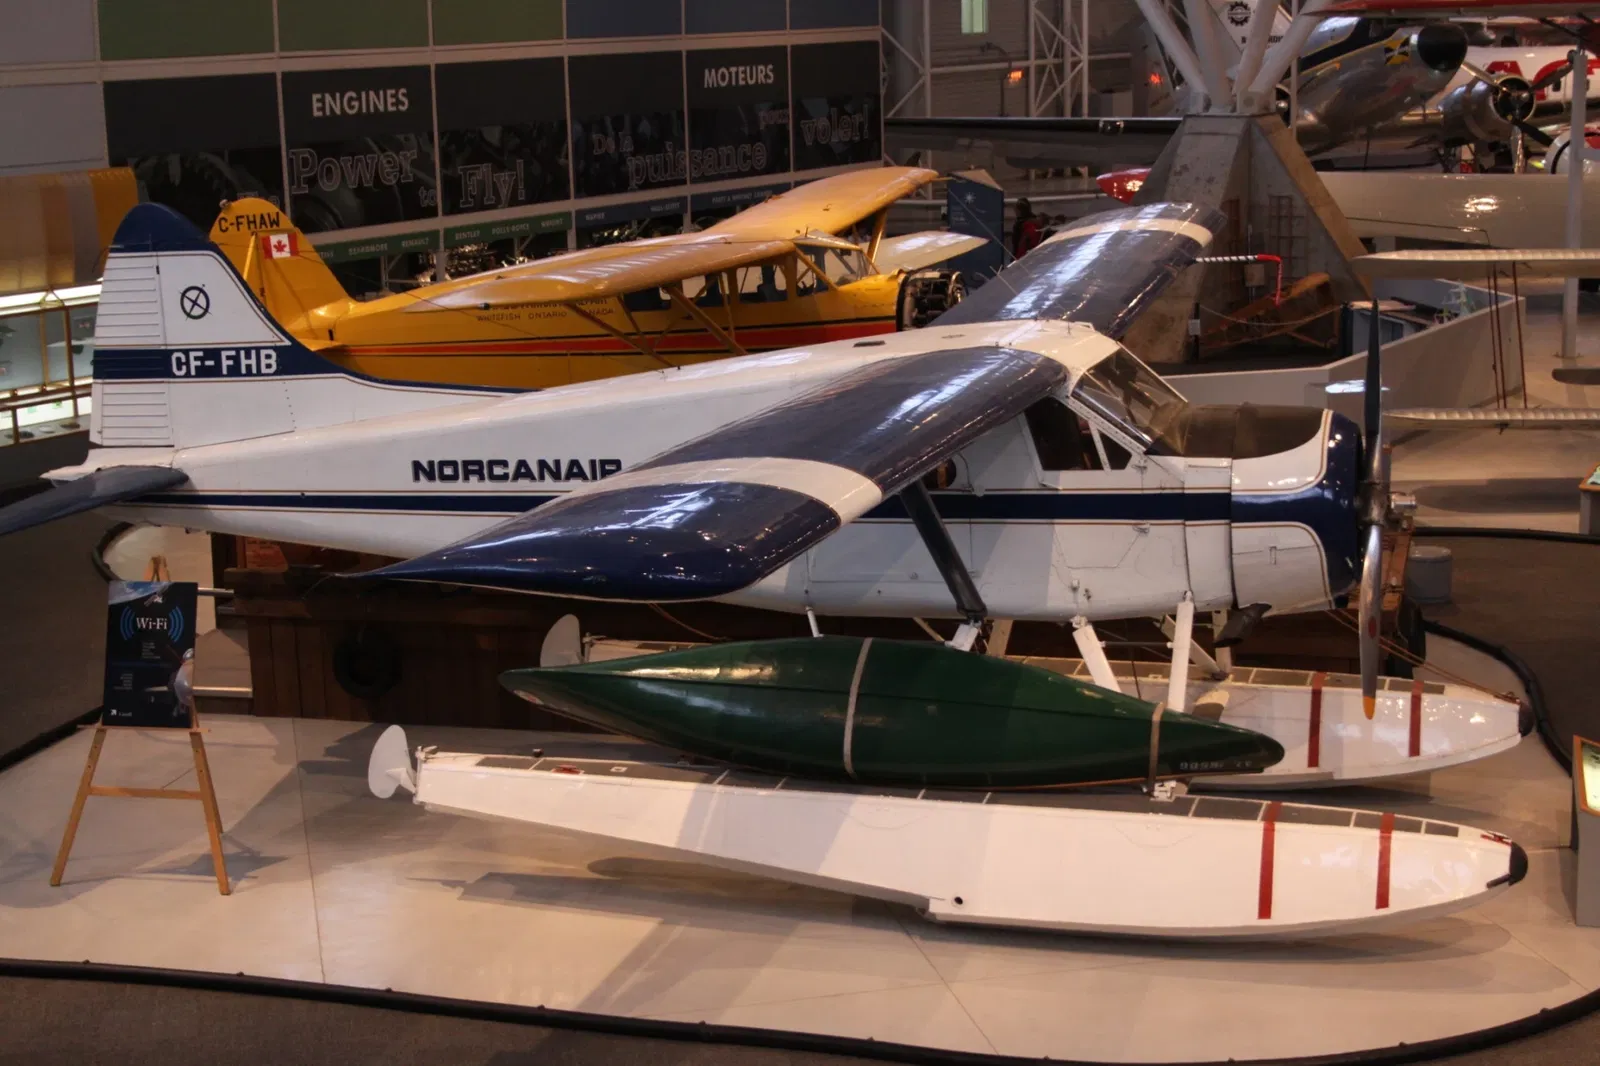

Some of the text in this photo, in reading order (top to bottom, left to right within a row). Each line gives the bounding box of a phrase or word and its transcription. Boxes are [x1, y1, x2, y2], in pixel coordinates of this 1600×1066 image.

[703, 64, 774, 88] MOTEURS
[311, 88, 409, 117] ENGINES
[800, 103, 870, 146] voler!
[288, 147, 526, 208] Power to Fly!
[627, 141, 768, 190] puissance
[217, 211, 280, 234] C-FHAW
[476, 313, 521, 322] WHITEFISH
[527, 310, 568, 320] ONTARIO
[171, 349, 277, 376] CF-FHB
[136, 617, 168, 631] Wi-Fi
